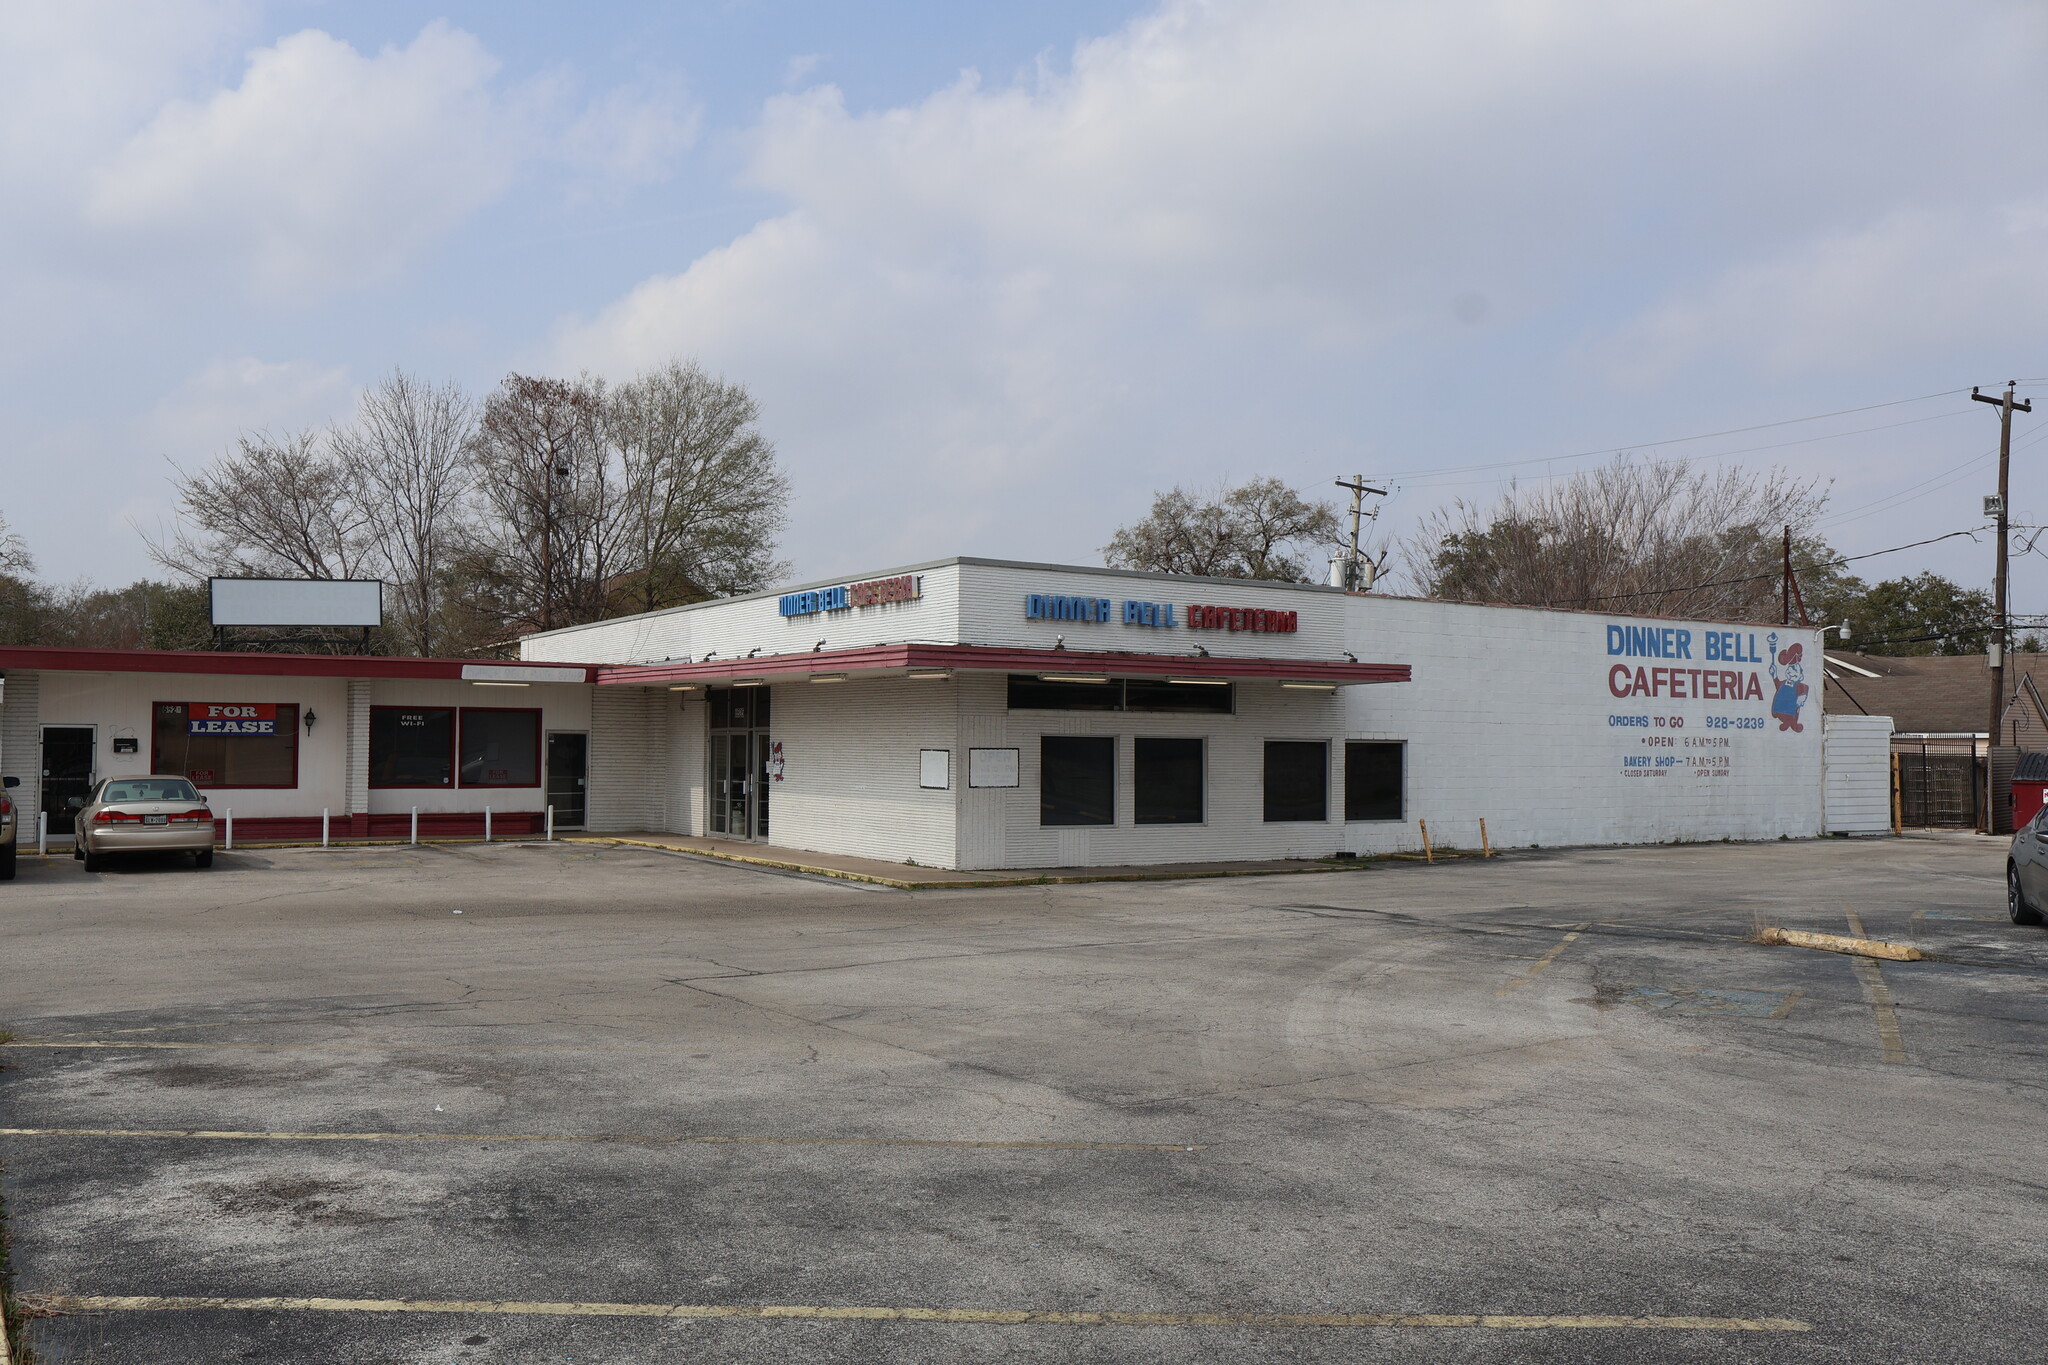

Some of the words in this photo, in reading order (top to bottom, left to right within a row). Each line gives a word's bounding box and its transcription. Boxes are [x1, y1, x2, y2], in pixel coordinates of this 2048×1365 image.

[779, 592, 817, 617] DINNER
[818, 586, 848, 611] BELL
[1027, 594, 1110, 622] DINNER
[1124, 600, 1179, 627] BELL
[1187, 605, 1297, 632] CAFETERIA
[1606, 624, 1692, 659] DINNER
[1705, 631, 1762, 663] BELL
[1608, 664, 1764, 700] CAFETERIA
[208, 705, 258, 717] FOR
[191, 720, 274, 733] LEASE
[1608, 715, 1649, 727] ORDERS
[1654, 716, 1665, 727] TO
[1669, 716, 1684, 728] GO
[1705, 716, 1765, 729] 928-3239
[1684, 737, 1689, 747] 6
[1713, 738, 1717, 747] 5
[1623, 756, 1651, 767] BAKERY
[1685, 757, 1690, 766] 7
[1712, 757, 1717, 766] 5
[1624, 769, 1642, 777] CLOSED
[1643, 769, 1667, 777] SATURDAY
[1697, 769, 1710, 777] OPEN
[1712, 769, 1729, 777] SUNDAY
